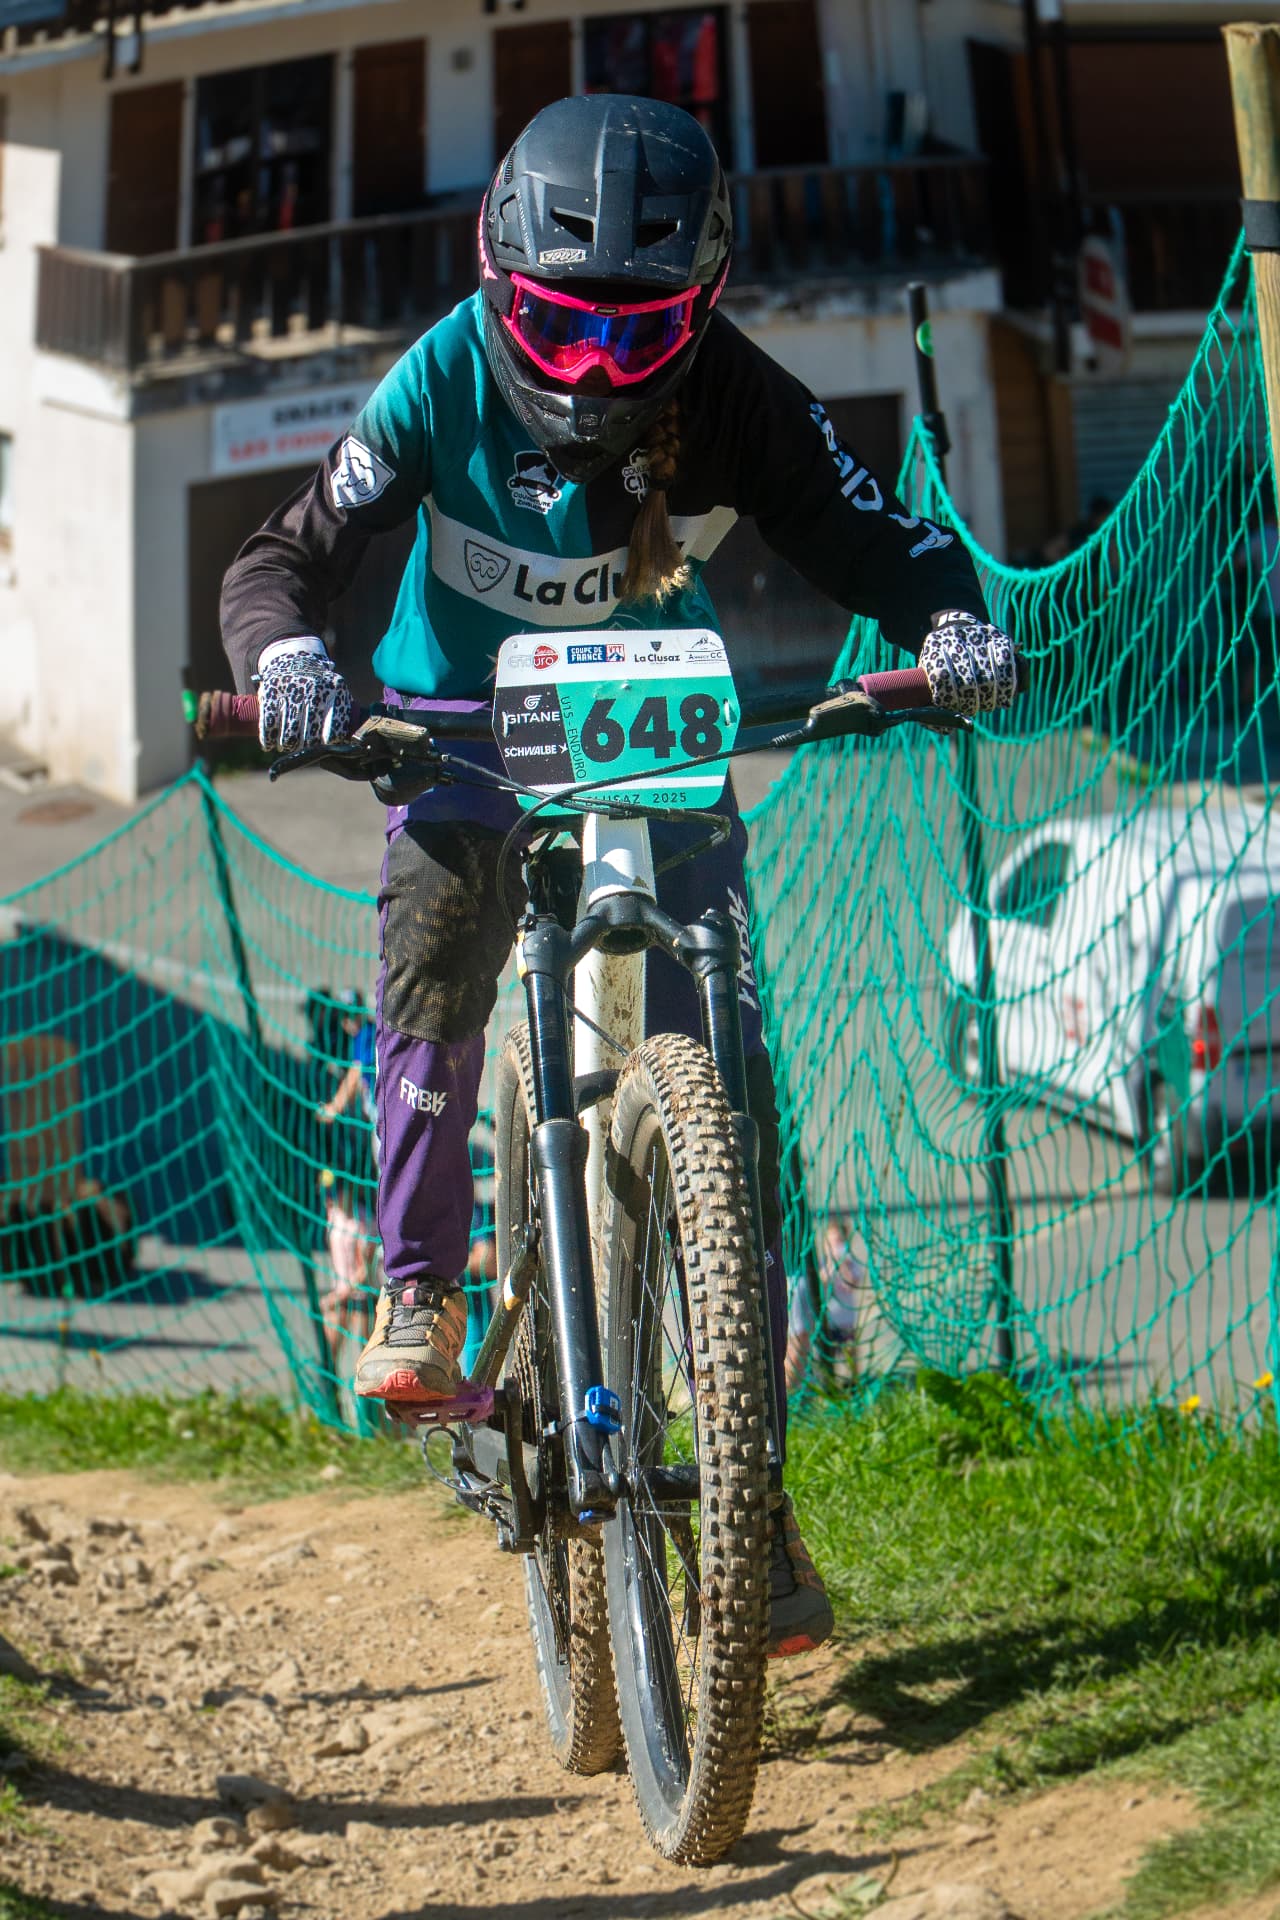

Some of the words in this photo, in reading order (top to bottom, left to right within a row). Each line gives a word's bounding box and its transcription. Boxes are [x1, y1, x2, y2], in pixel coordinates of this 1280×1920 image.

[514, 563, 566, 606] La
[571, 653, 604, 662] FRANCE
[634, 654, 646, 663] La
[647, 653, 681, 662] Clusaz
[561, 696, 574, 719] U15
[507, 711, 561, 725] GITANE
[580, 692, 723, 763] 648
[504, 744, 558, 758] SCHWALBE
[567, 728, 588, 779] ENDURO
[652, 792, 687, 804] 2025
